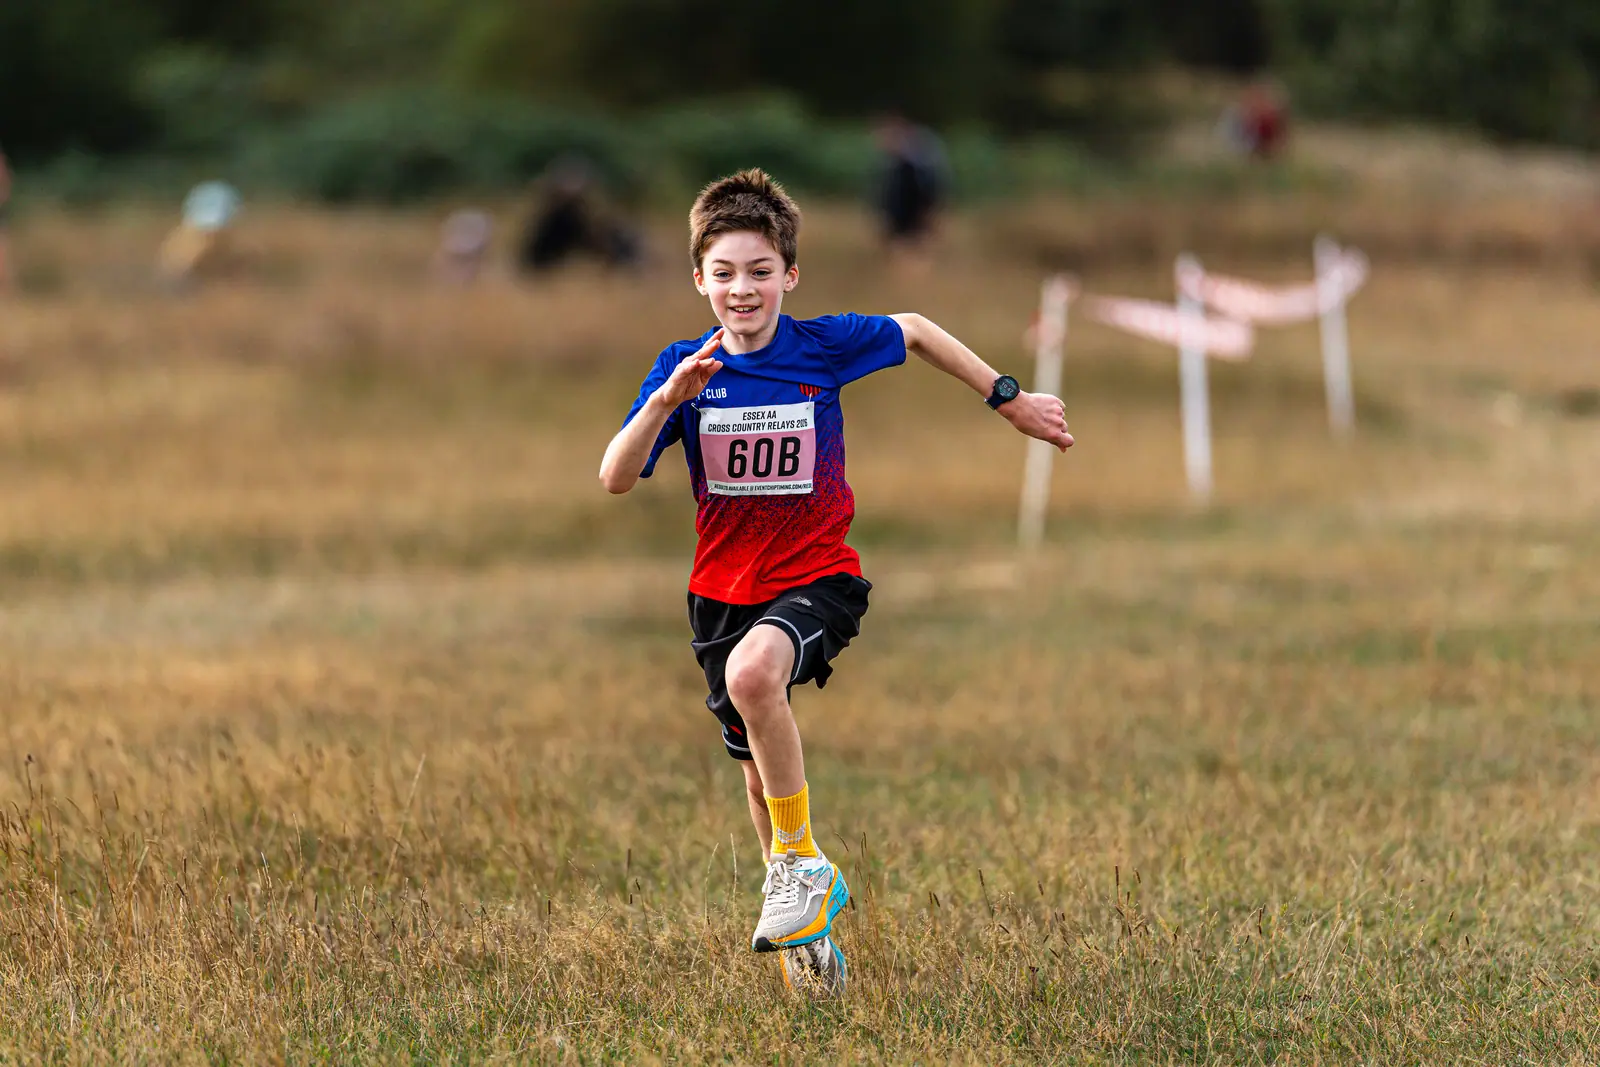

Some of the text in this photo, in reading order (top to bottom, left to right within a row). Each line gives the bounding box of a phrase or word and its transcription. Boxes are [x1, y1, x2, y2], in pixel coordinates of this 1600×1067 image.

[705, 387, 727, 399] CLUB
[742, 410, 777, 421] ESSEX AA
[707, 423, 731, 433] CROSS
[731, 422, 767, 432] COUNTRY
[767, 420, 795, 431] RELAYS
[727, 436, 801, 479] 60B
